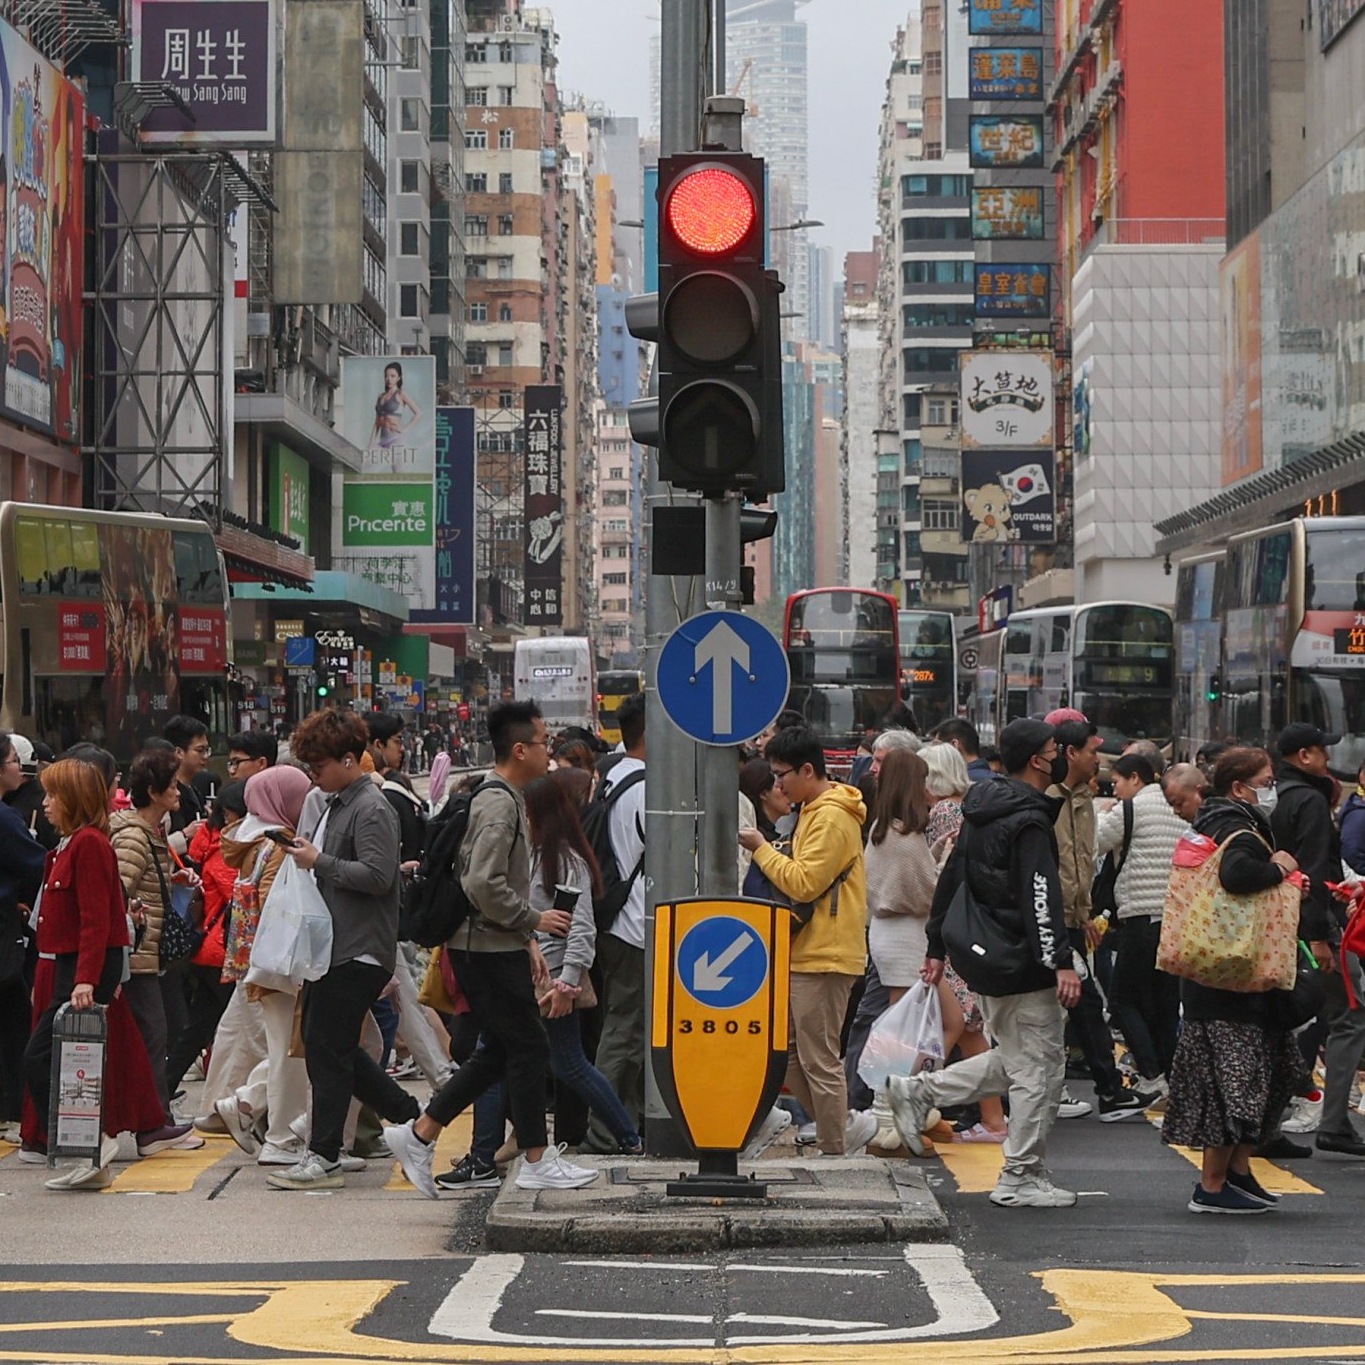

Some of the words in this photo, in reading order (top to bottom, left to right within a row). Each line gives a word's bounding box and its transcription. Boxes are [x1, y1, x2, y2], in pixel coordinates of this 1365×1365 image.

[163, 28, 248, 82] 周生生
[193, 83, 220, 105] Sang
[221, 83, 248, 105] Sang
[978, 125, 1035, 153] 世紀
[975, 188, 1040, 221] 亞洲
[995, 420, 1019, 436] 3/F
[528, 408, 549, 495] 六福珠寶
[391, 501, 427, 518] 實惠
[1012, 513, 1053, 522] OUTDARK
[348, 515, 427, 533] Pricerite
[237, 701, 255, 710] S18
[270, 704, 286, 714] S19
[1032, 870, 1054, 925] MOUSE
[678, 1020, 762, 1036] 3805
